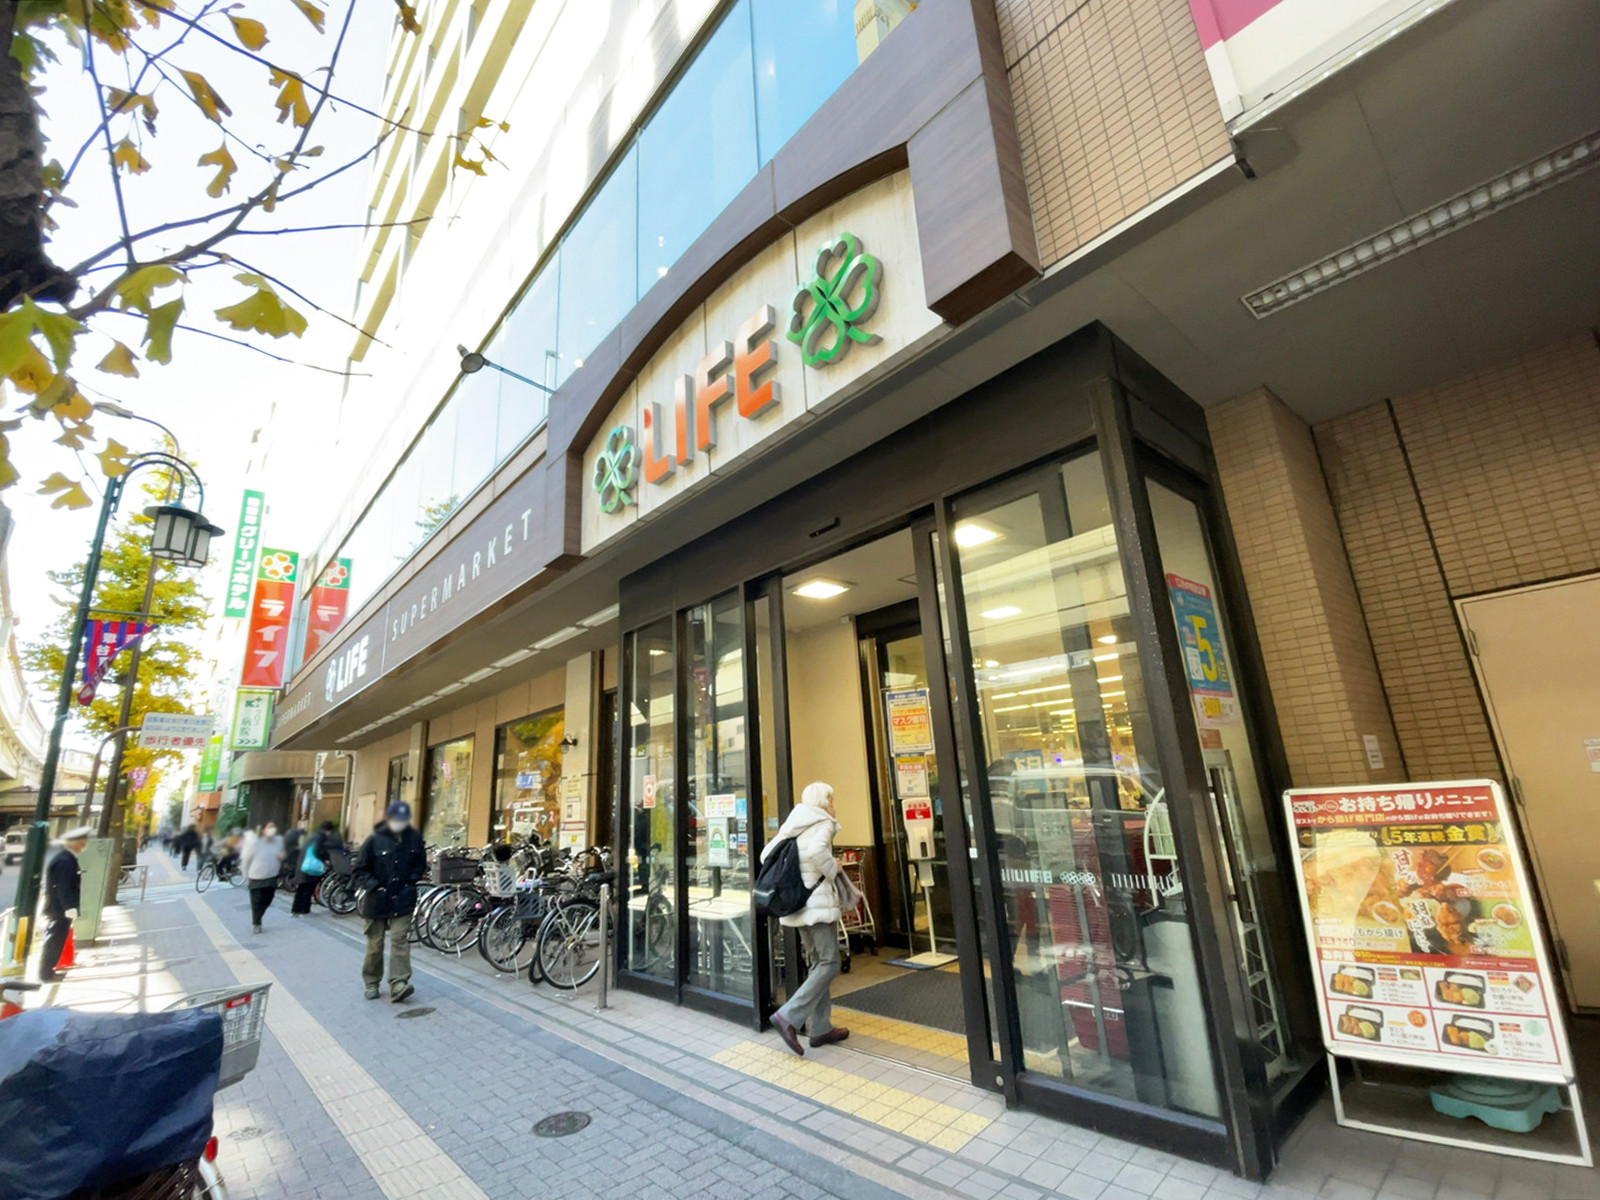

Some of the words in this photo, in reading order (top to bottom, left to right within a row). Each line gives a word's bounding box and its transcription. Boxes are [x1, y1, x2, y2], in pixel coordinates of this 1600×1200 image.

[644, 303, 780, 484] LIFE
[227, 496, 260, 610] グリーンホテル
[391, 508, 532, 641] SUPERMARKET
[254, 598, 285, 667] ライフ
[336, 634, 370, 692] LIFE
[145, 735, 206, 747] 歩行者優先
[1339, 792, 1489, 813] お持ち帰りメニュー
